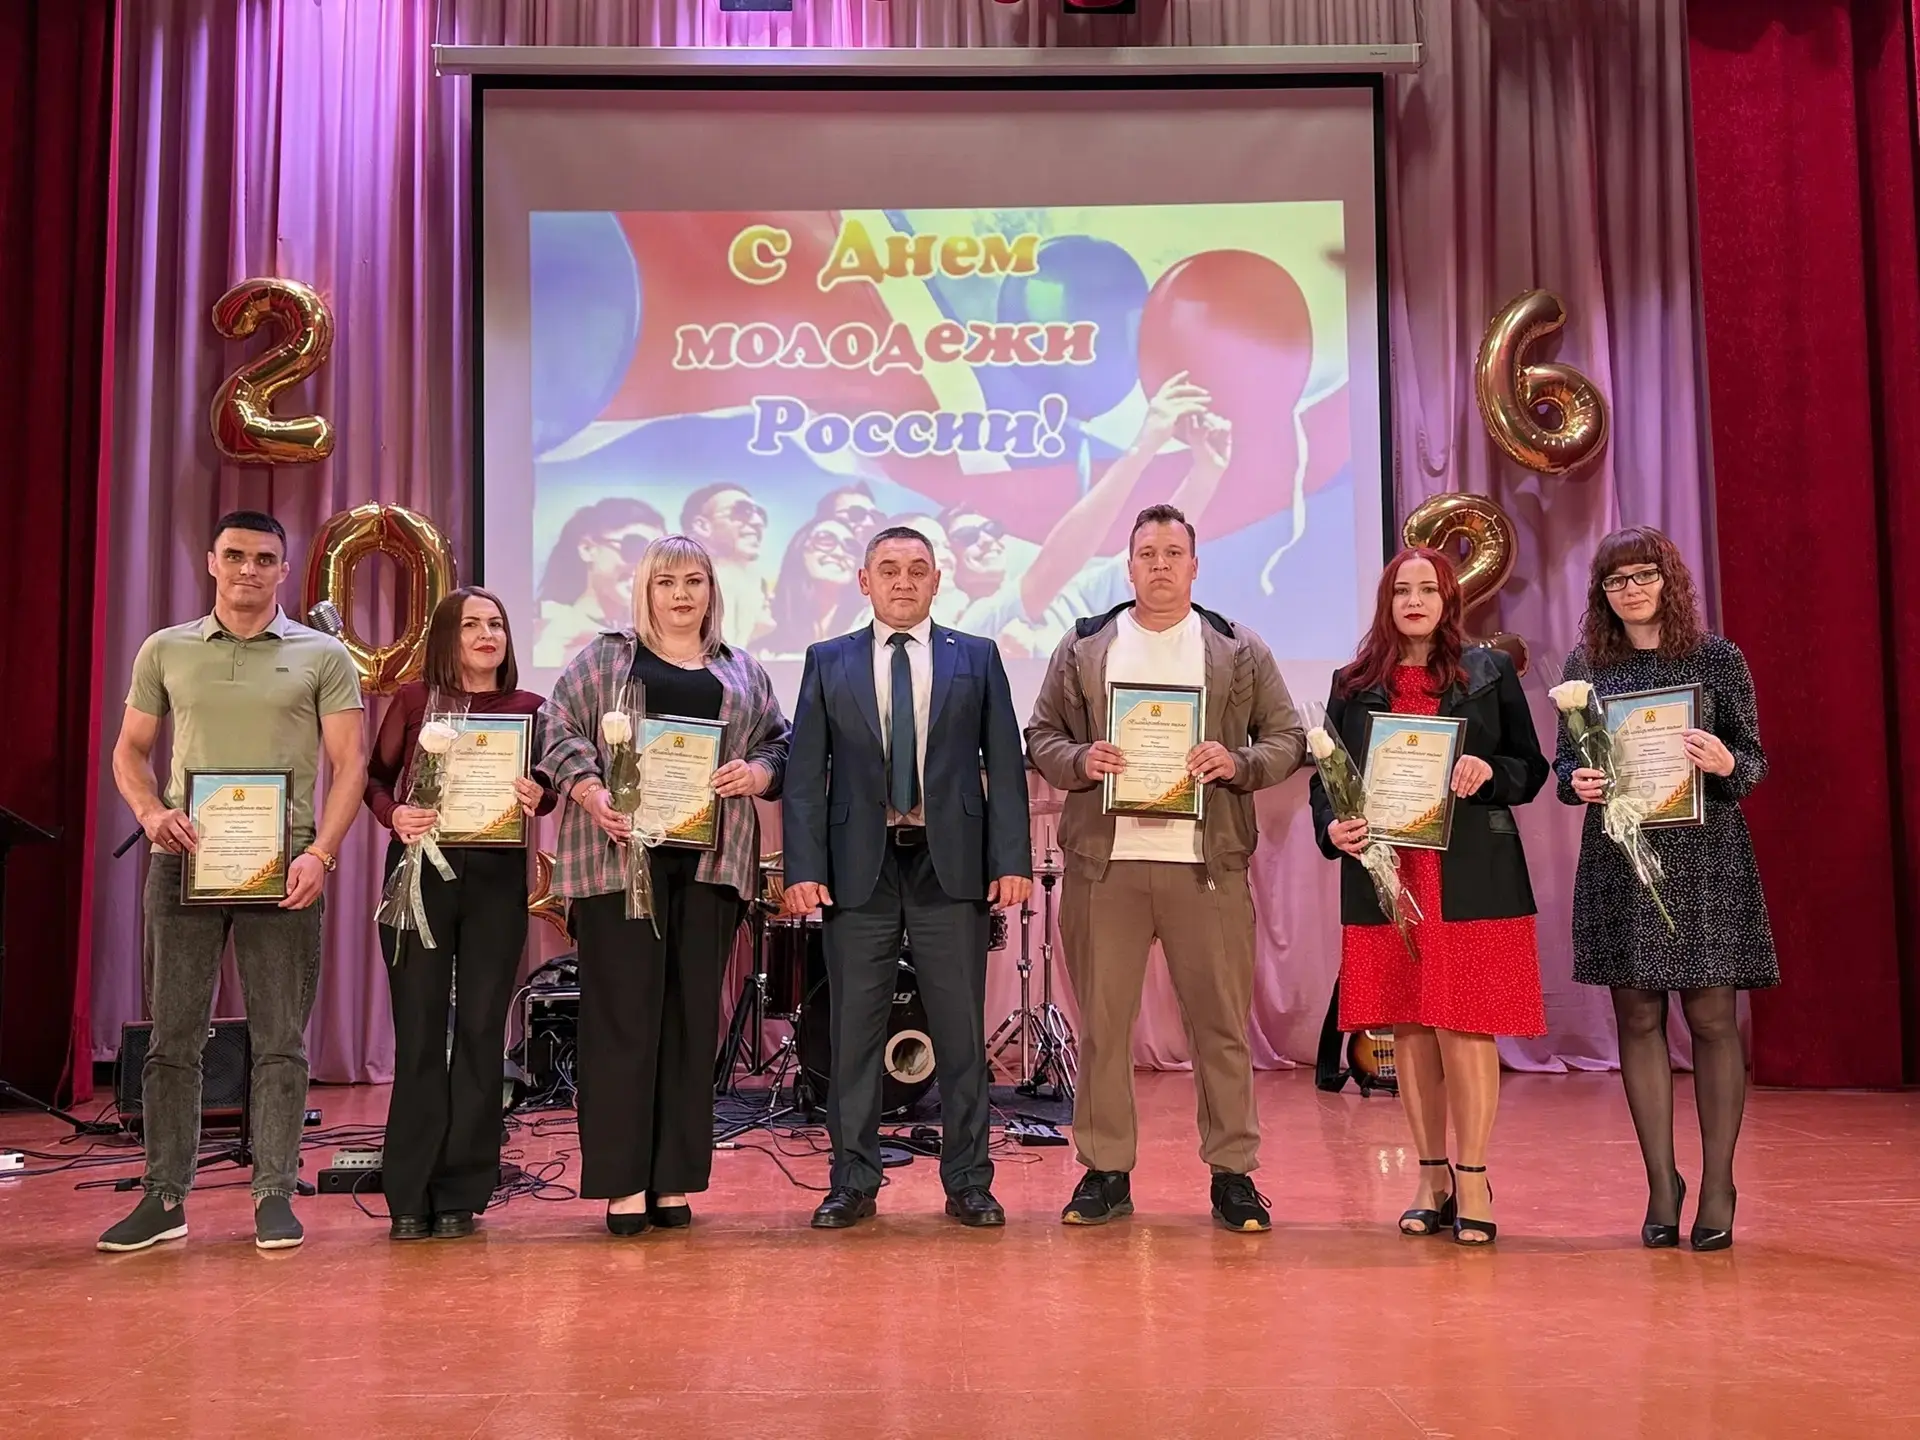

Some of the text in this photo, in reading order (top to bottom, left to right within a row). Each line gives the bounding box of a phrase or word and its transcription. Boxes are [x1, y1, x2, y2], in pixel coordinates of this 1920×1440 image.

[728, 217, 1041, 293] С Днем
[211, 277, 335, 464] 2
[672, 320, 1099, 376] молодежи
[1475, 288, 1609, 475] 6
[747, 393, 1068, 458] России!
